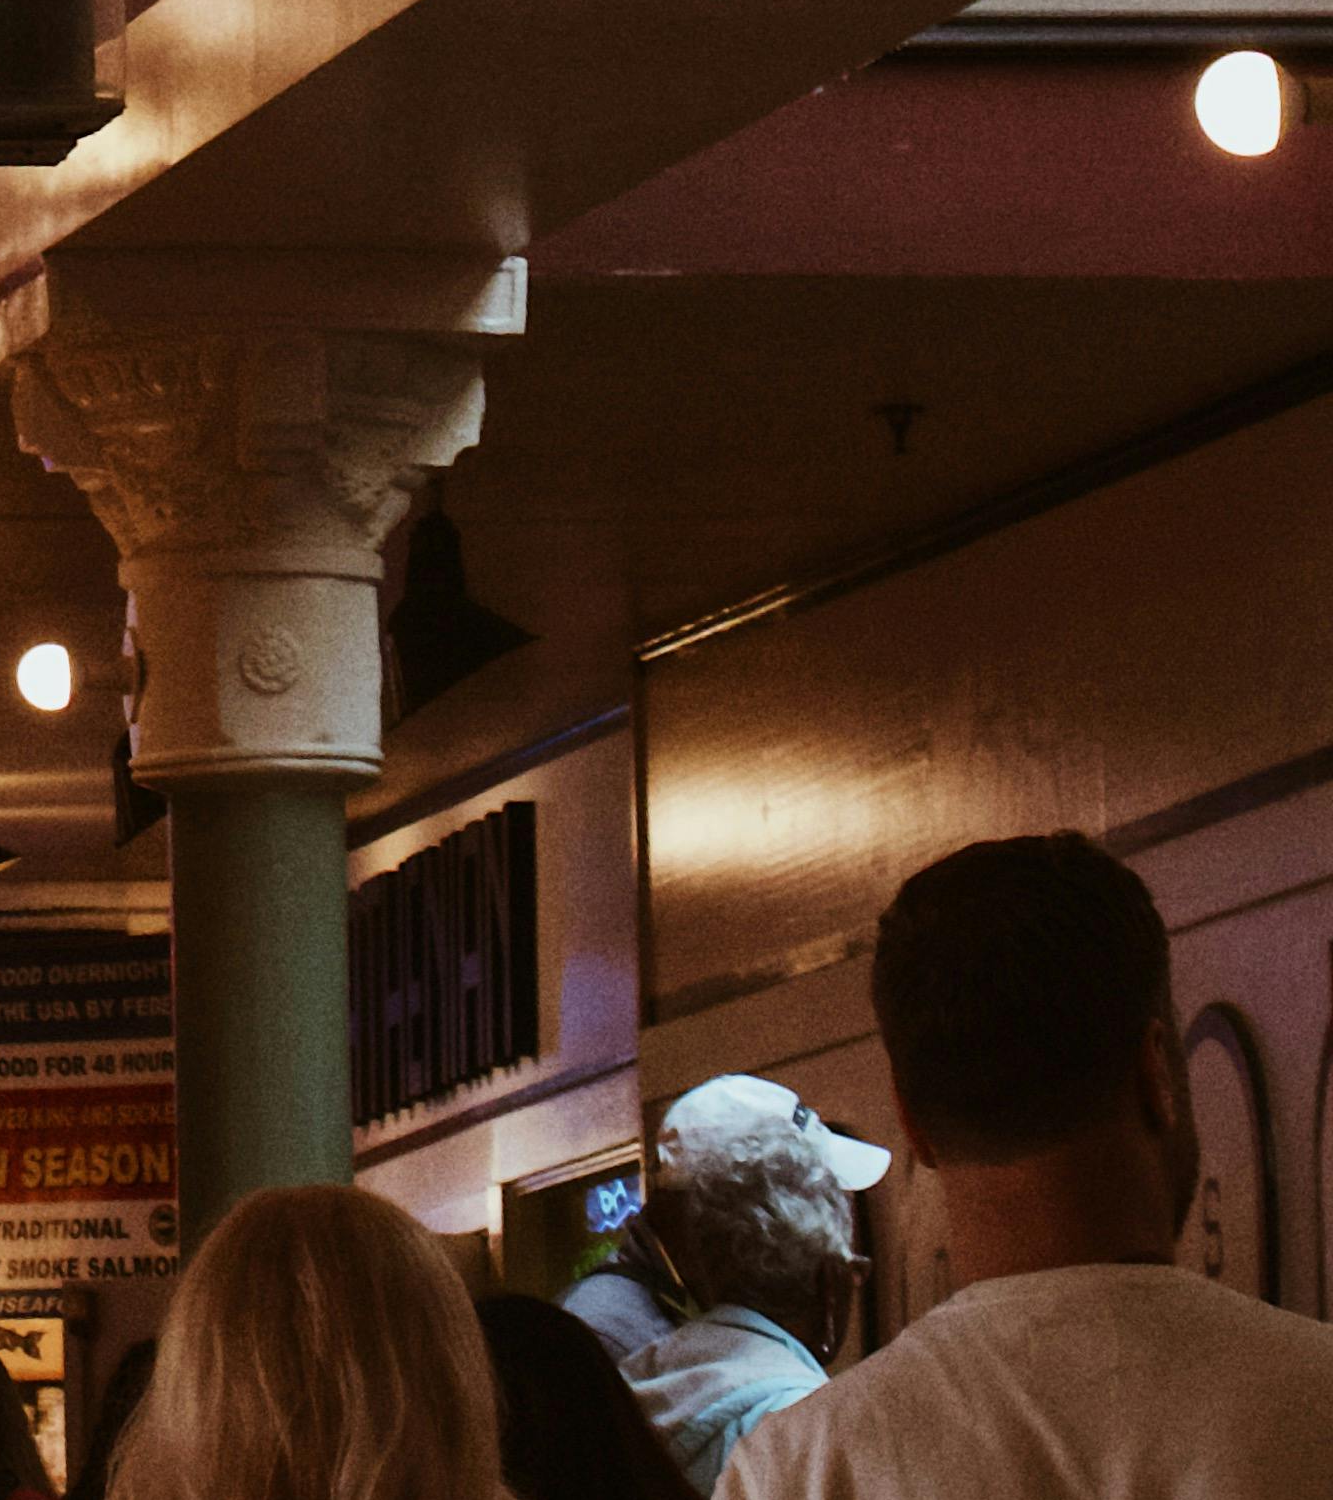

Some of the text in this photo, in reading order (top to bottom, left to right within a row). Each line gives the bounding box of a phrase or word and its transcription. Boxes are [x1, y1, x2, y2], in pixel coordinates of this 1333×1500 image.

[48, 959, 171, 986] OVERNIGHT
[37, 999, 80, 1022] USA
[85, 997, 115, 1020] BY
[122, 993, 171, 1018] FEDE
[44, 1055, 87, 1076] FOR
[92, 1054, 115, 1074] 48
[121, 1051, 175, 1073] HOUR
[21, 1142, 171, 1188] SEASON
[6, 1256, 80, 1280] SMOKE
